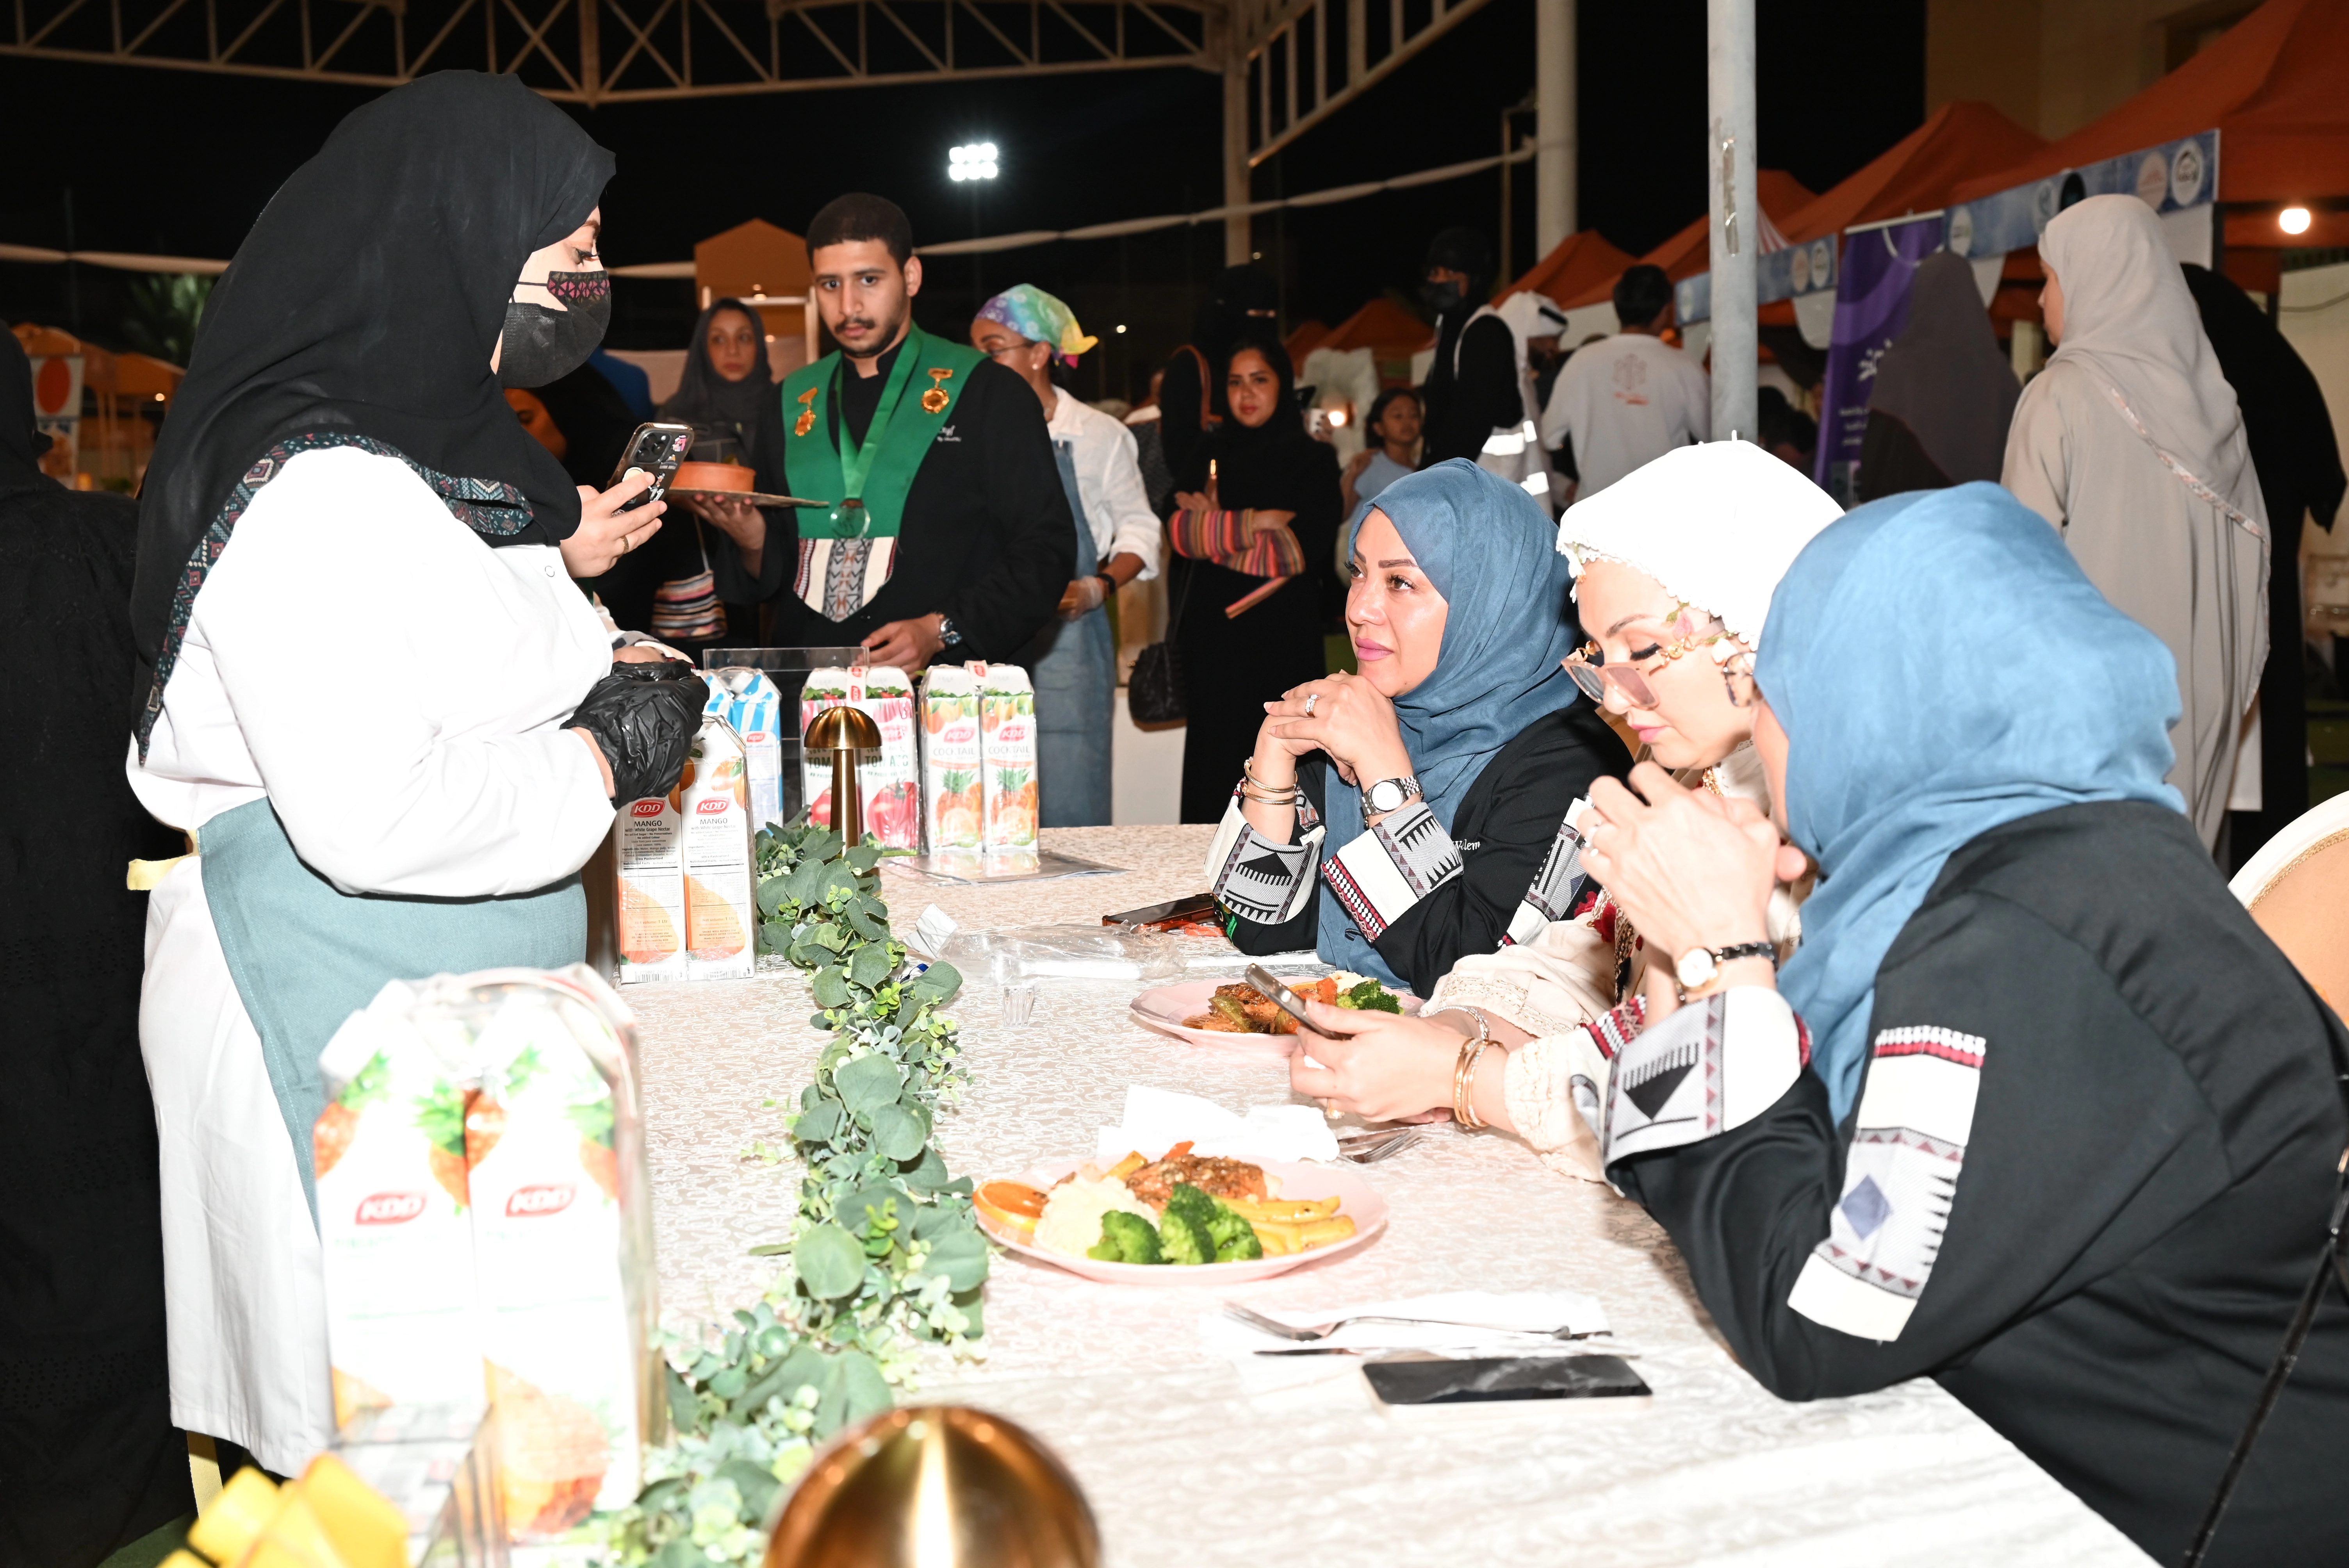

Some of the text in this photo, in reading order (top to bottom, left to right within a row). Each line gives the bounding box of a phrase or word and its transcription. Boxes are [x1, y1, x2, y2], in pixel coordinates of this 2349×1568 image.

[947, 731, 971, 739] KDD
[1002, 729, 1026, 738] KDD
[933, 748, 975, 756] COCKTAIL
[989, 746, 1030, 754] COCKTAIL
[634, 804, 660, 813] KDD
[700, 802, 726, 811] KDD
[511, 1188, 570, 1213] KDD
[361, 1197, 422, 1220] KDD
